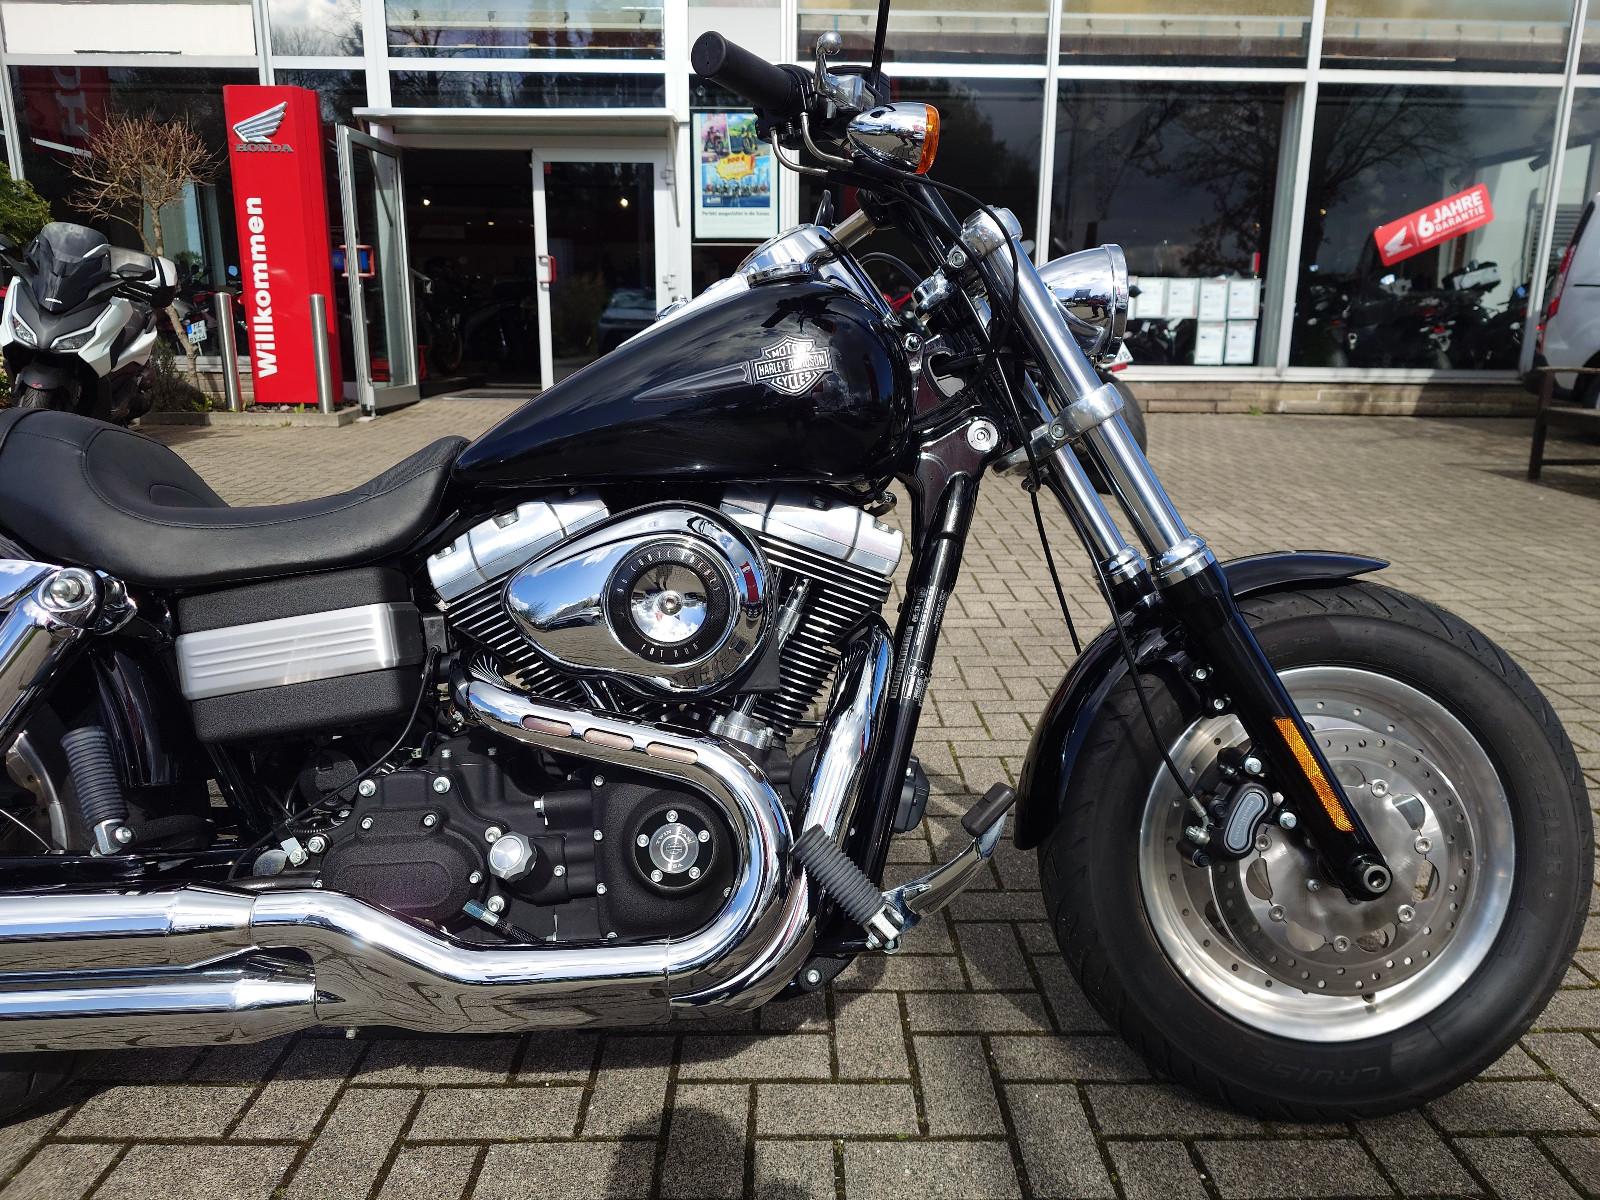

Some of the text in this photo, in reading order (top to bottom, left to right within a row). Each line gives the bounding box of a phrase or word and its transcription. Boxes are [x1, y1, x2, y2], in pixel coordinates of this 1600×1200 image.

[234, 143, 295, 153] HONDA
[1418, 190, 1483, 238] 6 JAHRE
[1435, 206, 1486, 232] GARANTIE
[246, 196, 278, 378] Willkommen
[771, 342, 806, 358] MOTO
[758, 354, 825, 376] HARLEY-DIDSON
[776, 371, 812, 389] CYCLES
